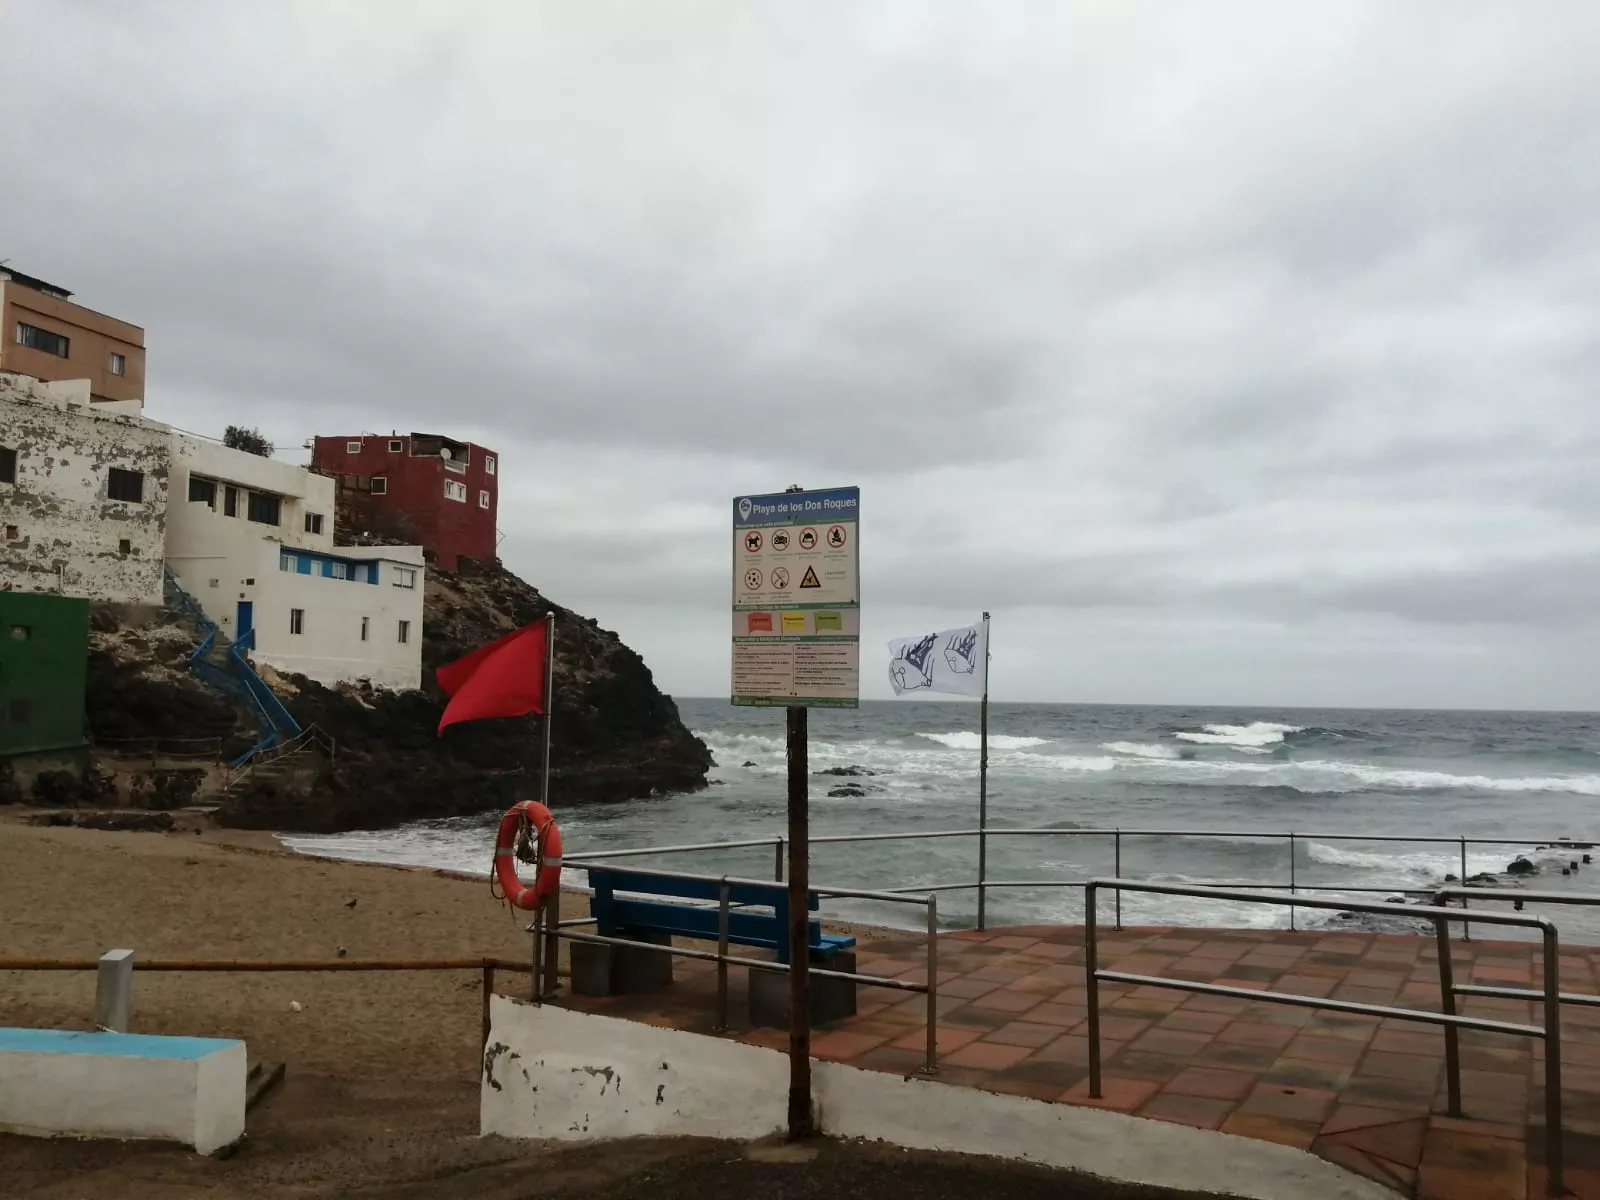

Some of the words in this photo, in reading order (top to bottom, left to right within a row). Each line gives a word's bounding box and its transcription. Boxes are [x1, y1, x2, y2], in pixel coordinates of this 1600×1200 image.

[753, 504, 775, 515] Playa
[777, 503, 788, 512] de
[790, 502, 803, 512] los
[805, 500, 822, 510] Dos
[824, 499, 856, 510] Roques
